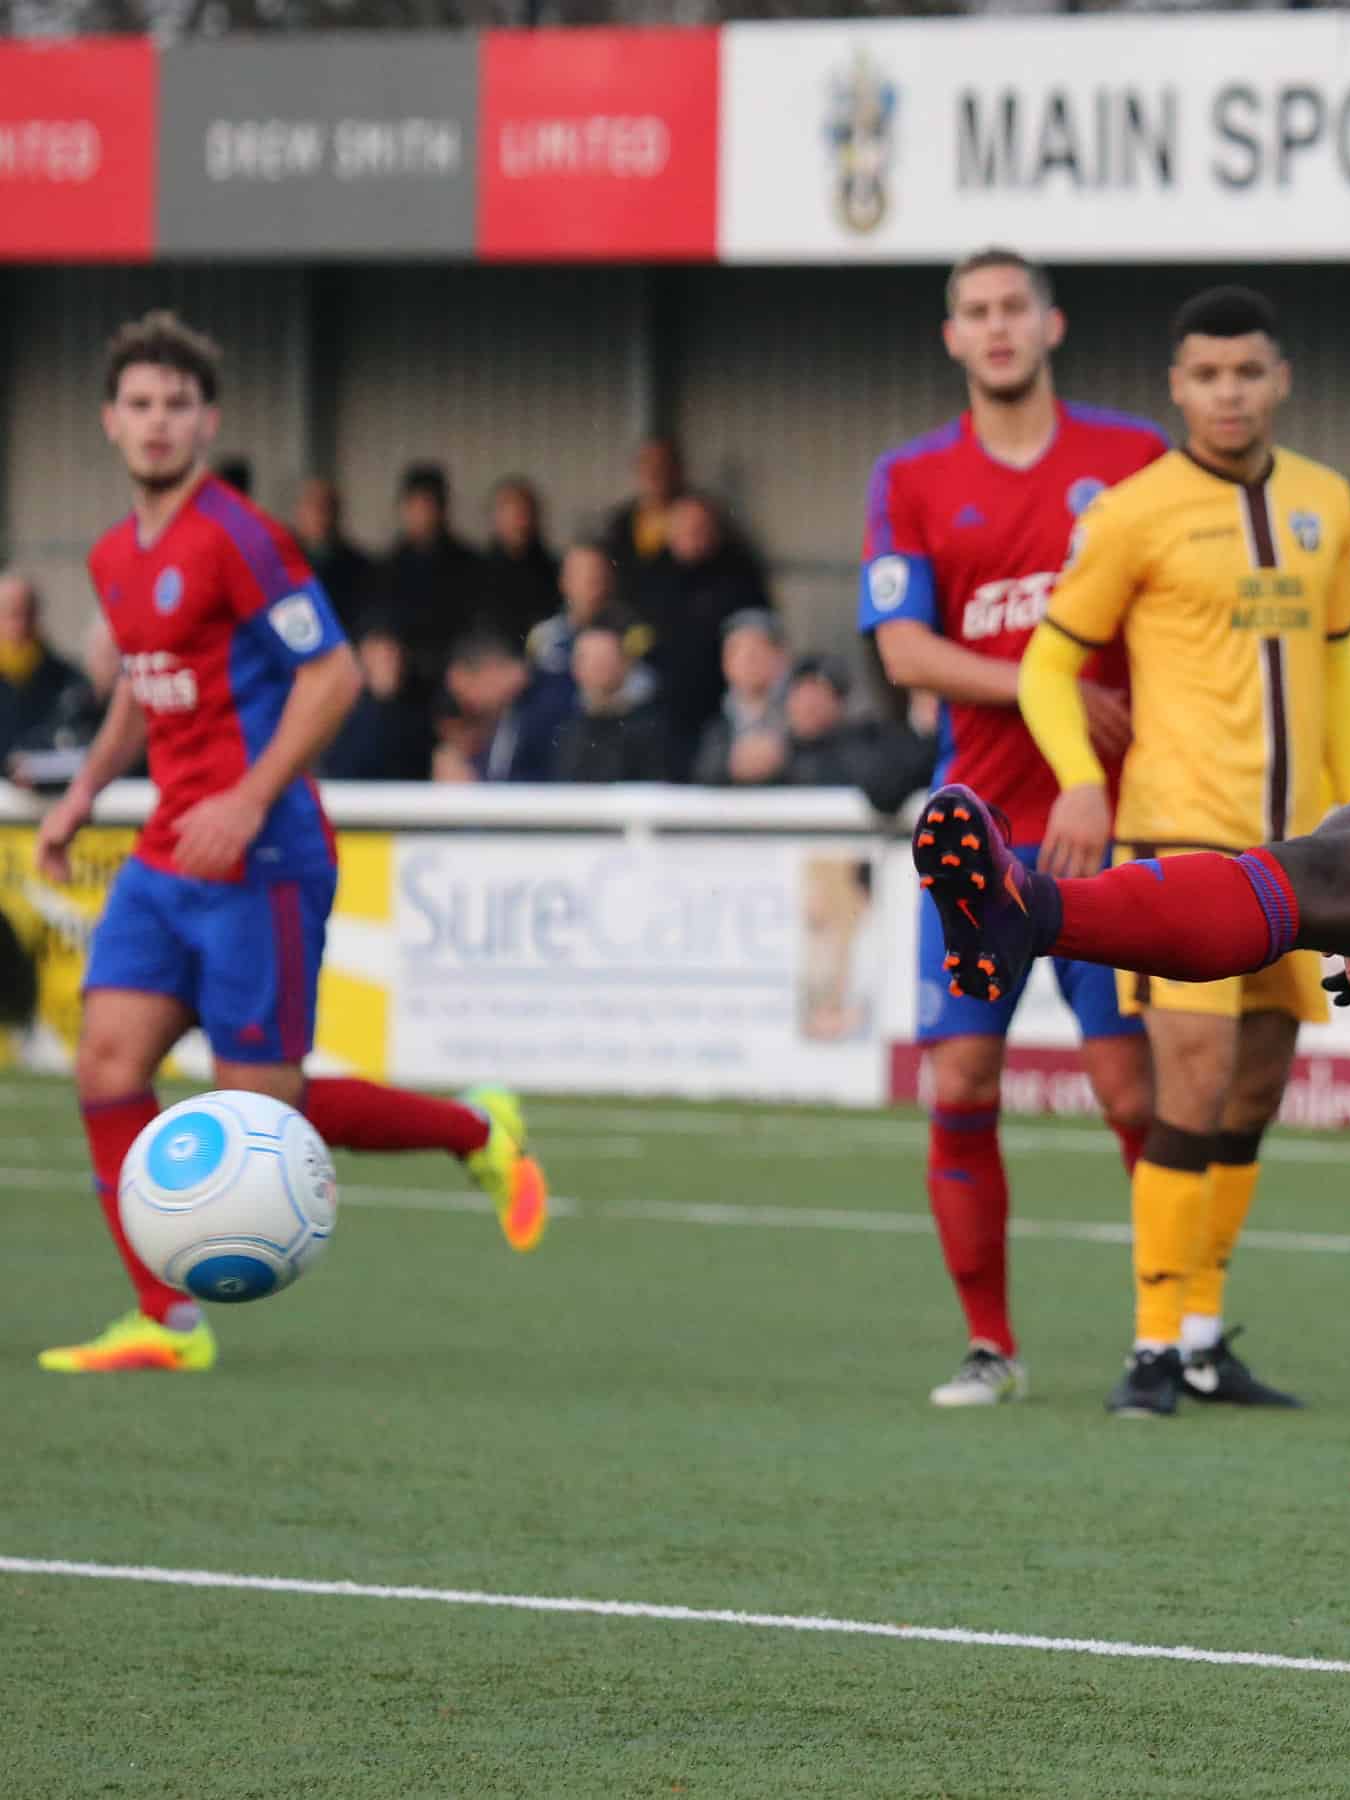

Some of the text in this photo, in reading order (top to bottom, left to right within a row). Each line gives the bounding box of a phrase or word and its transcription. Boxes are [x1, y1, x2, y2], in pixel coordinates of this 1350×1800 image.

[331, 117, 462, 180] SMITH
[499, 116, 668, 179] LIMITED
[957, 88, 1176, 190] MAIN
